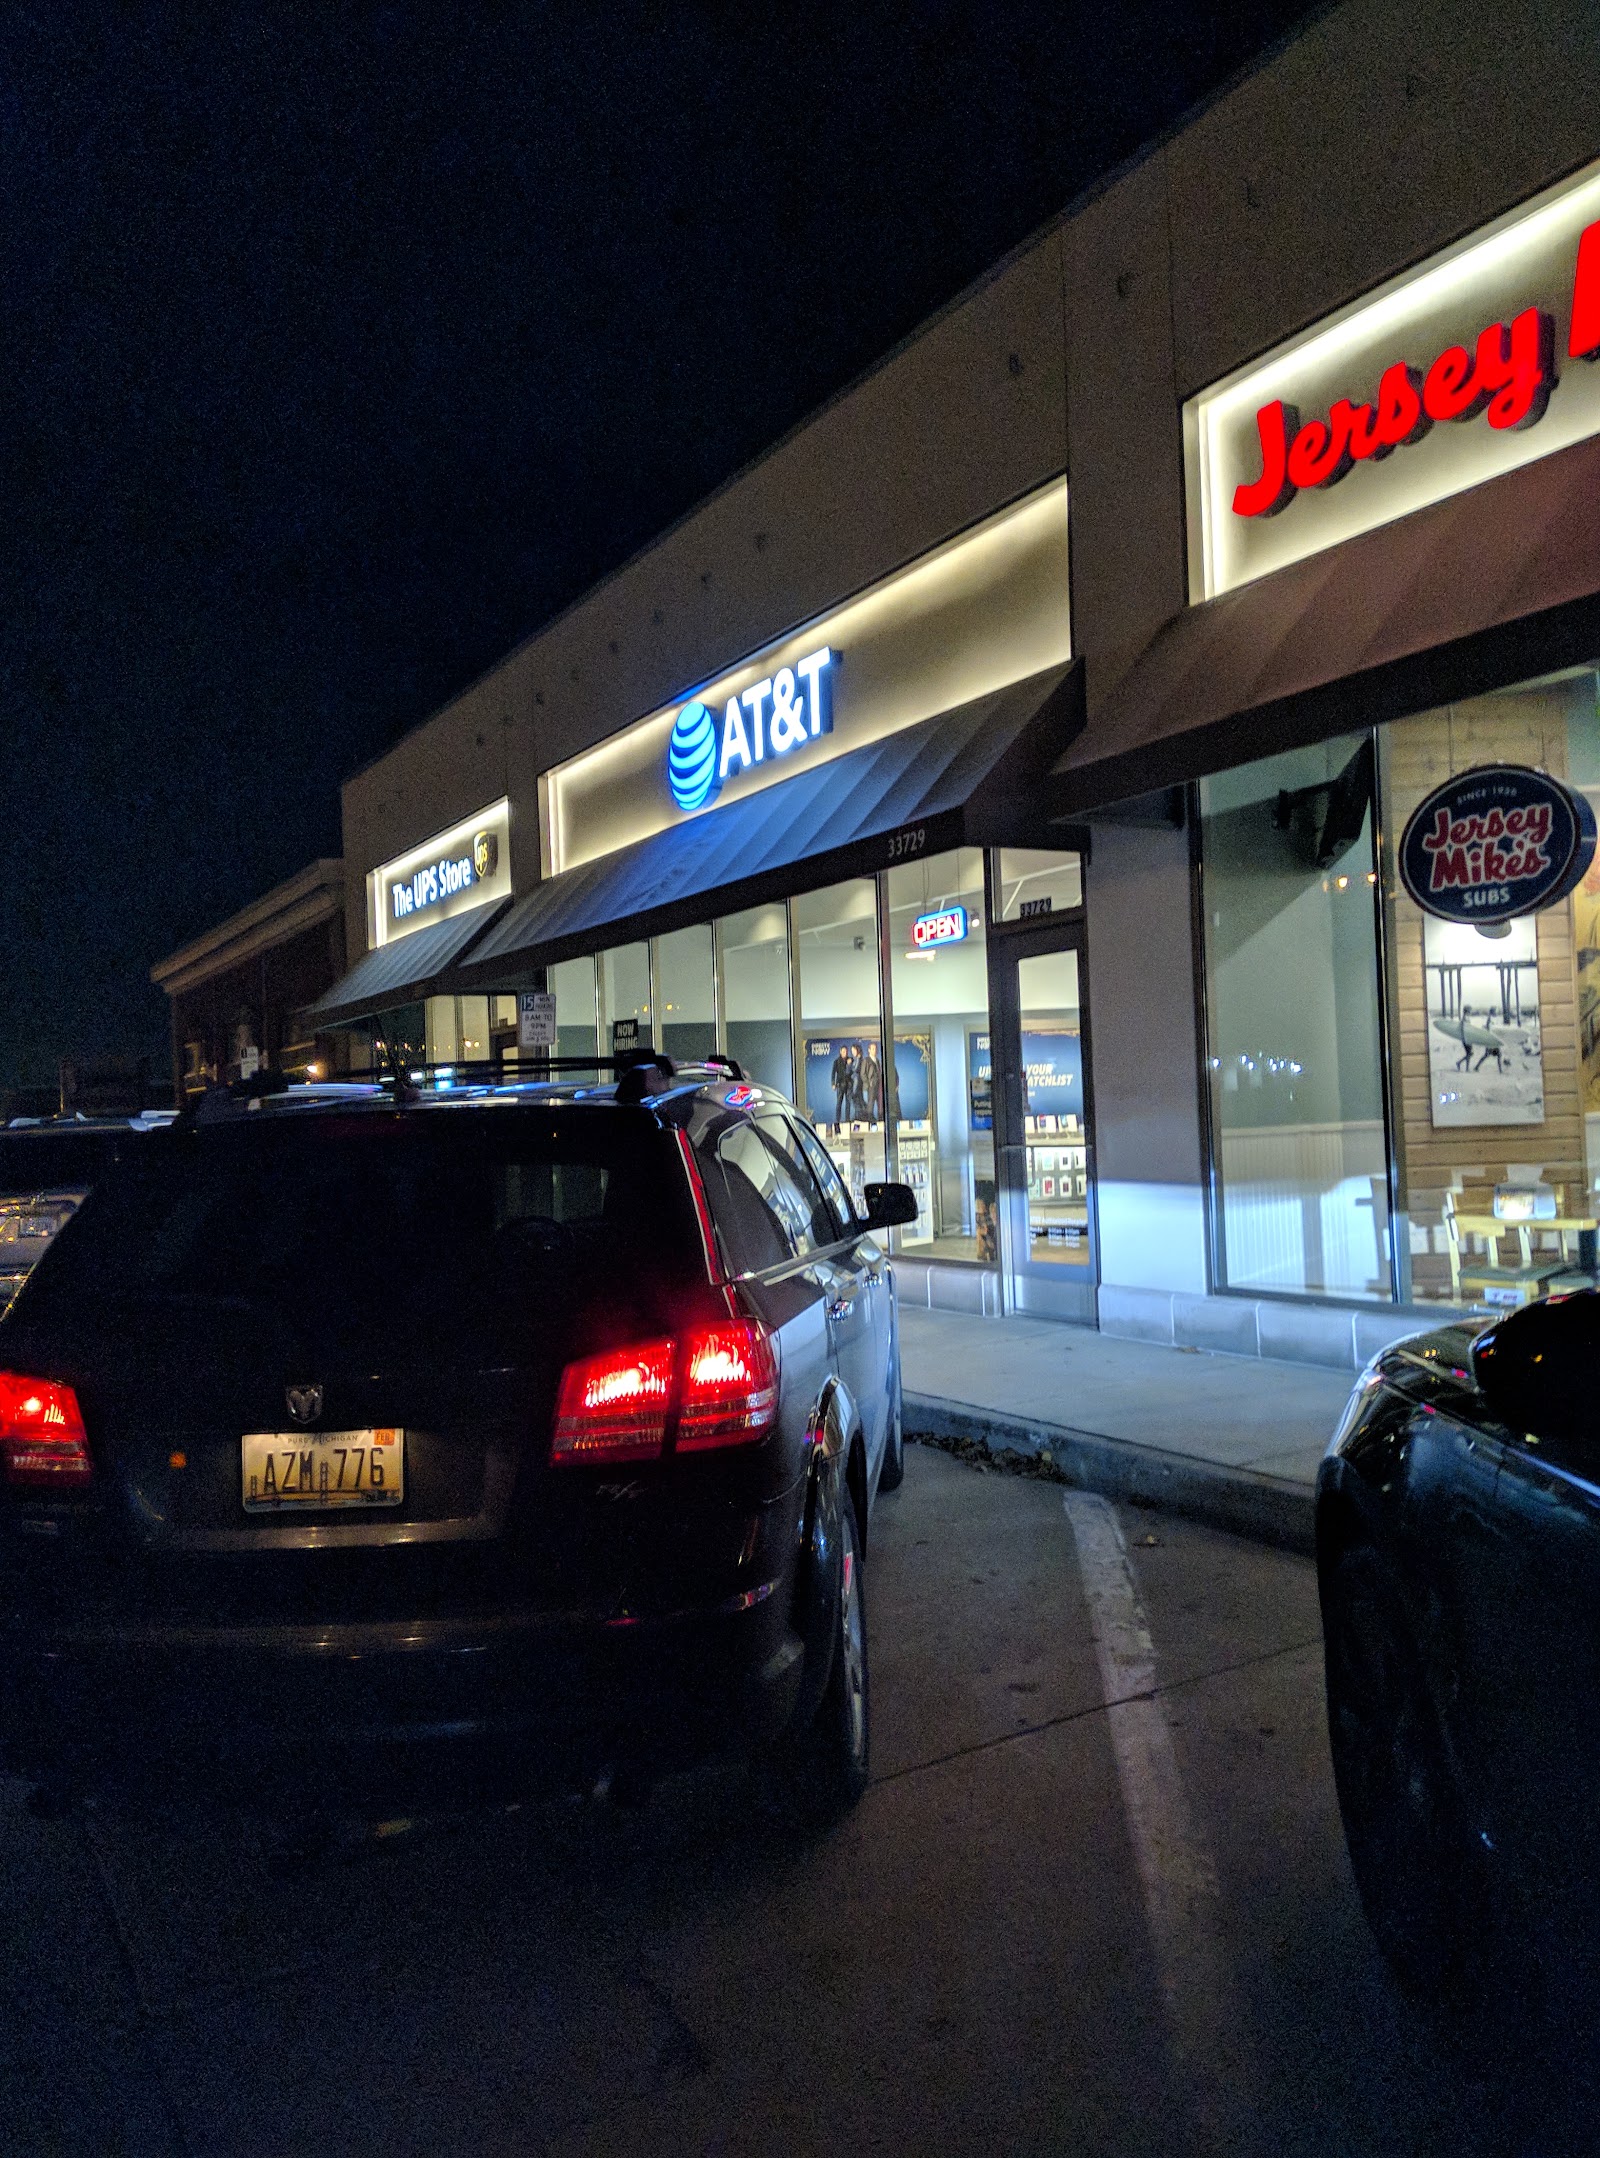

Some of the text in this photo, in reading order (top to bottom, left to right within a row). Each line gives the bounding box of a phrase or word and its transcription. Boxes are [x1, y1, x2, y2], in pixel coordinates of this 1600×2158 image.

[1232, 306, 1542, 517] Jersey
[719, 646, 831, 778] AT&T
[1422, 803, 1552, 850] Jersey
[475, 842, 488, 872] ups
[887, 828, 926, 858] 33729
[1430, 840, 1551, 892] Mike's
[392, 857, 472, 918] The UPS Store
[1463, 887, 1511, 908] SUBS
[913, 914, 962, 945] OPEN
[523, 995, 534, 1010] 15
[613, 1037, 638, 1051] HIRING
[617, 1023, 634, 1037] NOW
[1026, 1063, 1054, 1075] YOUR
[1026, 1074, 1073, 1087] ATCHLIST
[264, 1447, 385, 1494] AZM 776
